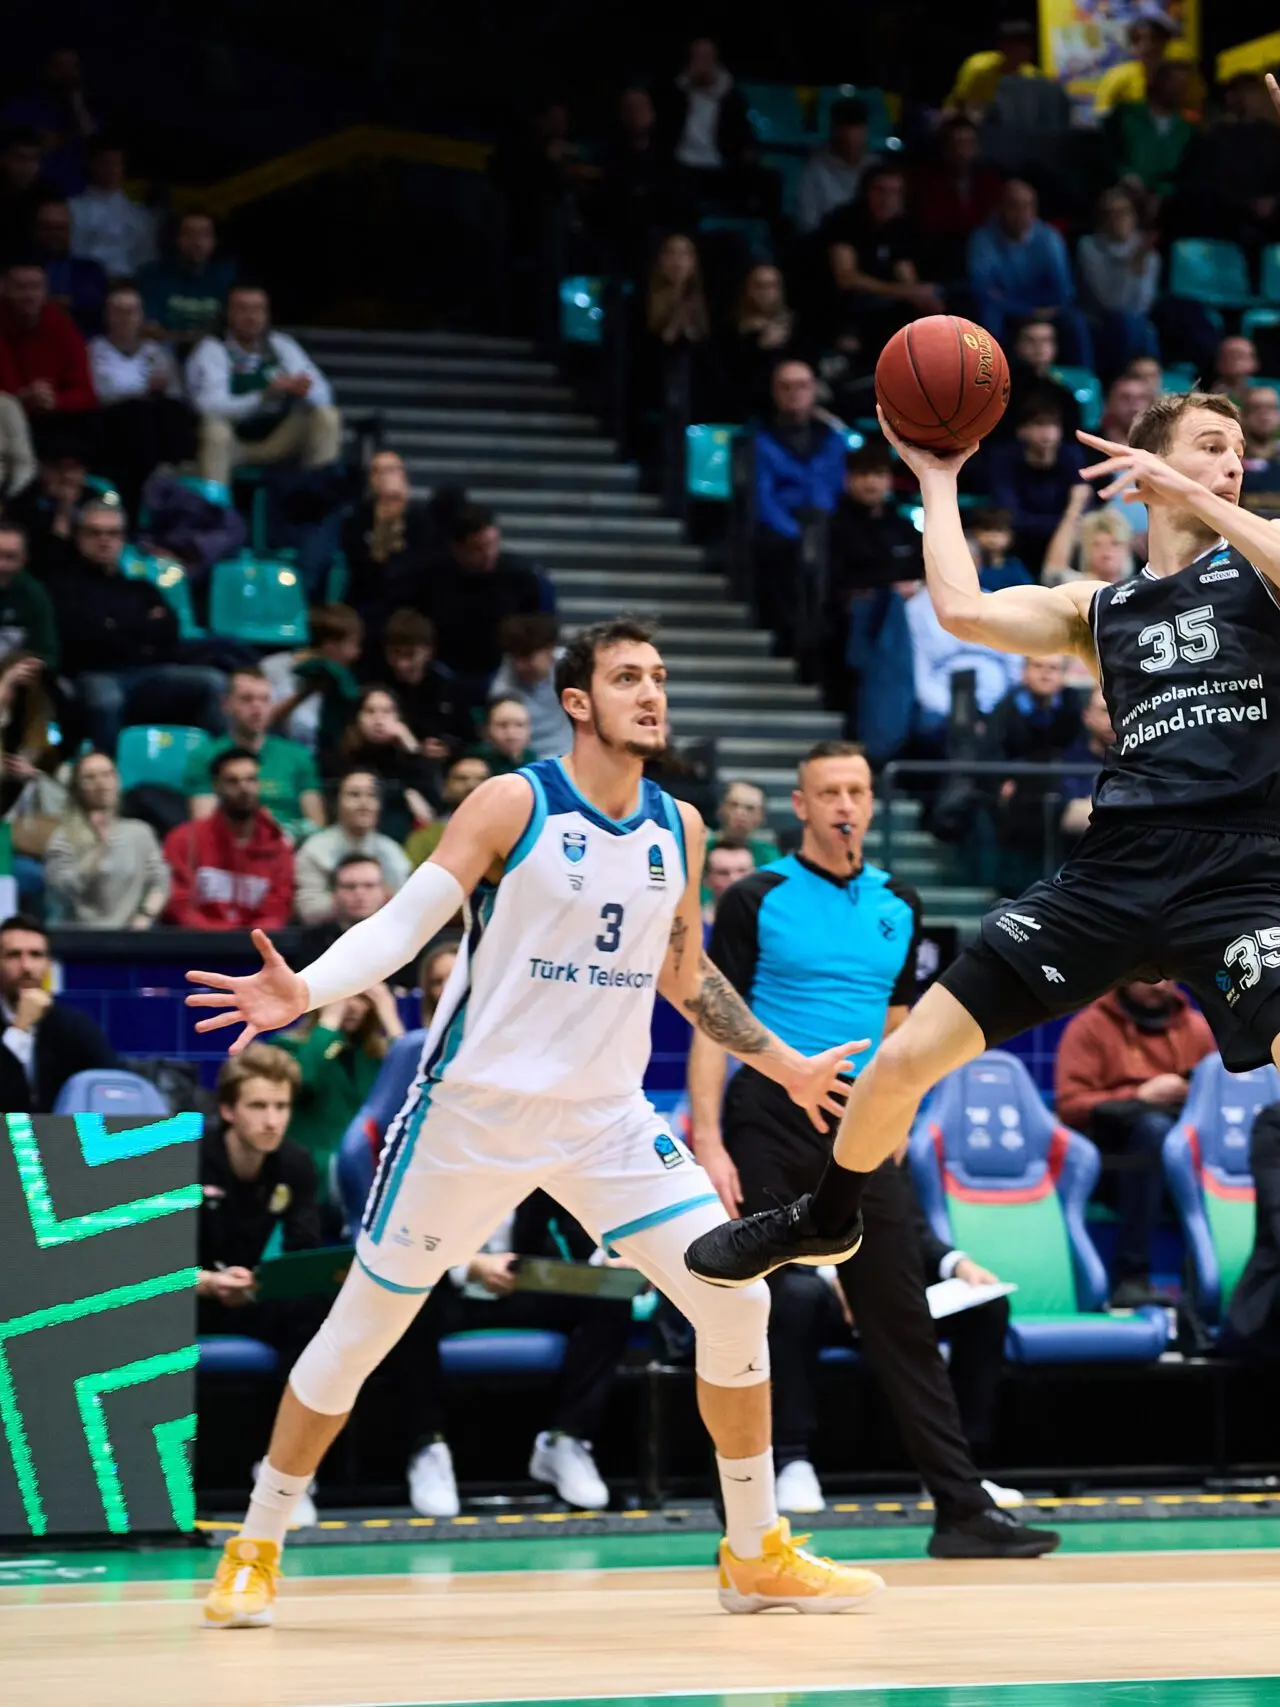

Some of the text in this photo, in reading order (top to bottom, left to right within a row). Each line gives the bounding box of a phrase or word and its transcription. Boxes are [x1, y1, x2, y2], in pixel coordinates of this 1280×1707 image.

[1138, 604, 1220, 673] 35
[1121, 698, 1268, 756] Poland.Travel
[1122, 674, 1264, 727] www.poland.travel
[596, 903, 624, 952] 3
[529, 958, 580, 983] Türk
